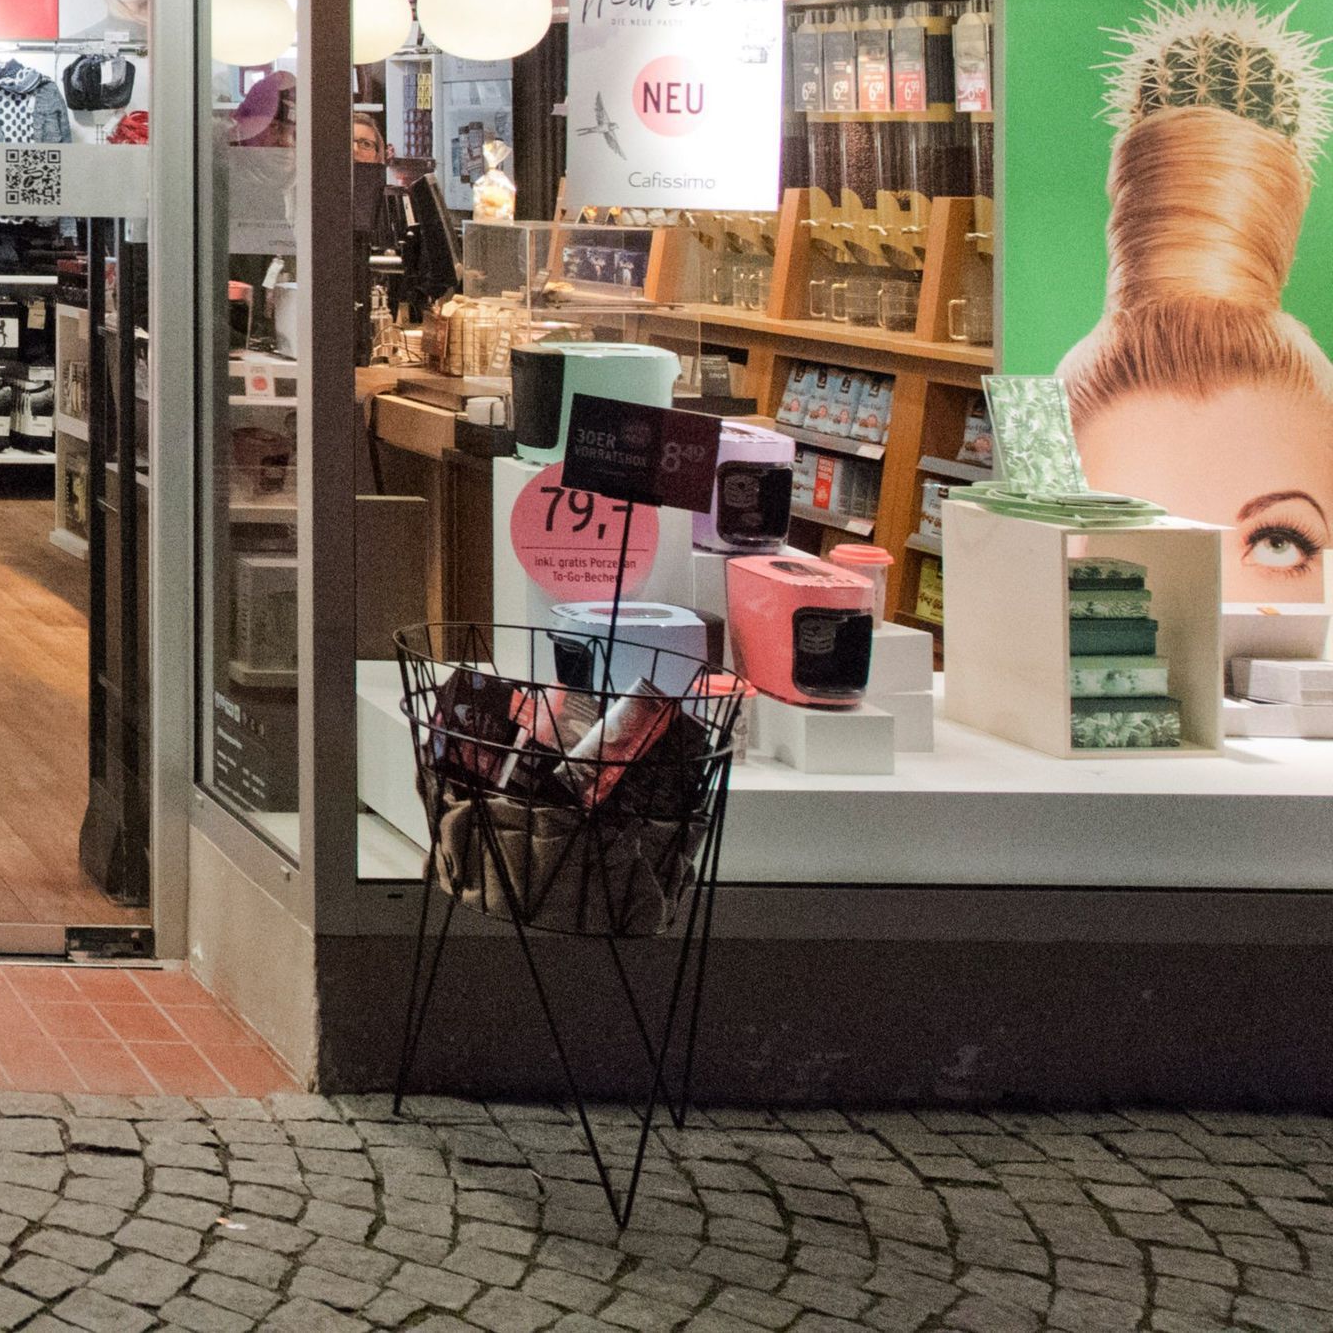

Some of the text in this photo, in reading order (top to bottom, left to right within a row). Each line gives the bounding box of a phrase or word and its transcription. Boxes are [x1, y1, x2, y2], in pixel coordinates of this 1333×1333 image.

[642, 81, 705, 115] NEU
[627, 170, 716, 190] Cafissimo
[558, 556, 589, 570] gratis
[590, 557, 637, 569] Porzean
